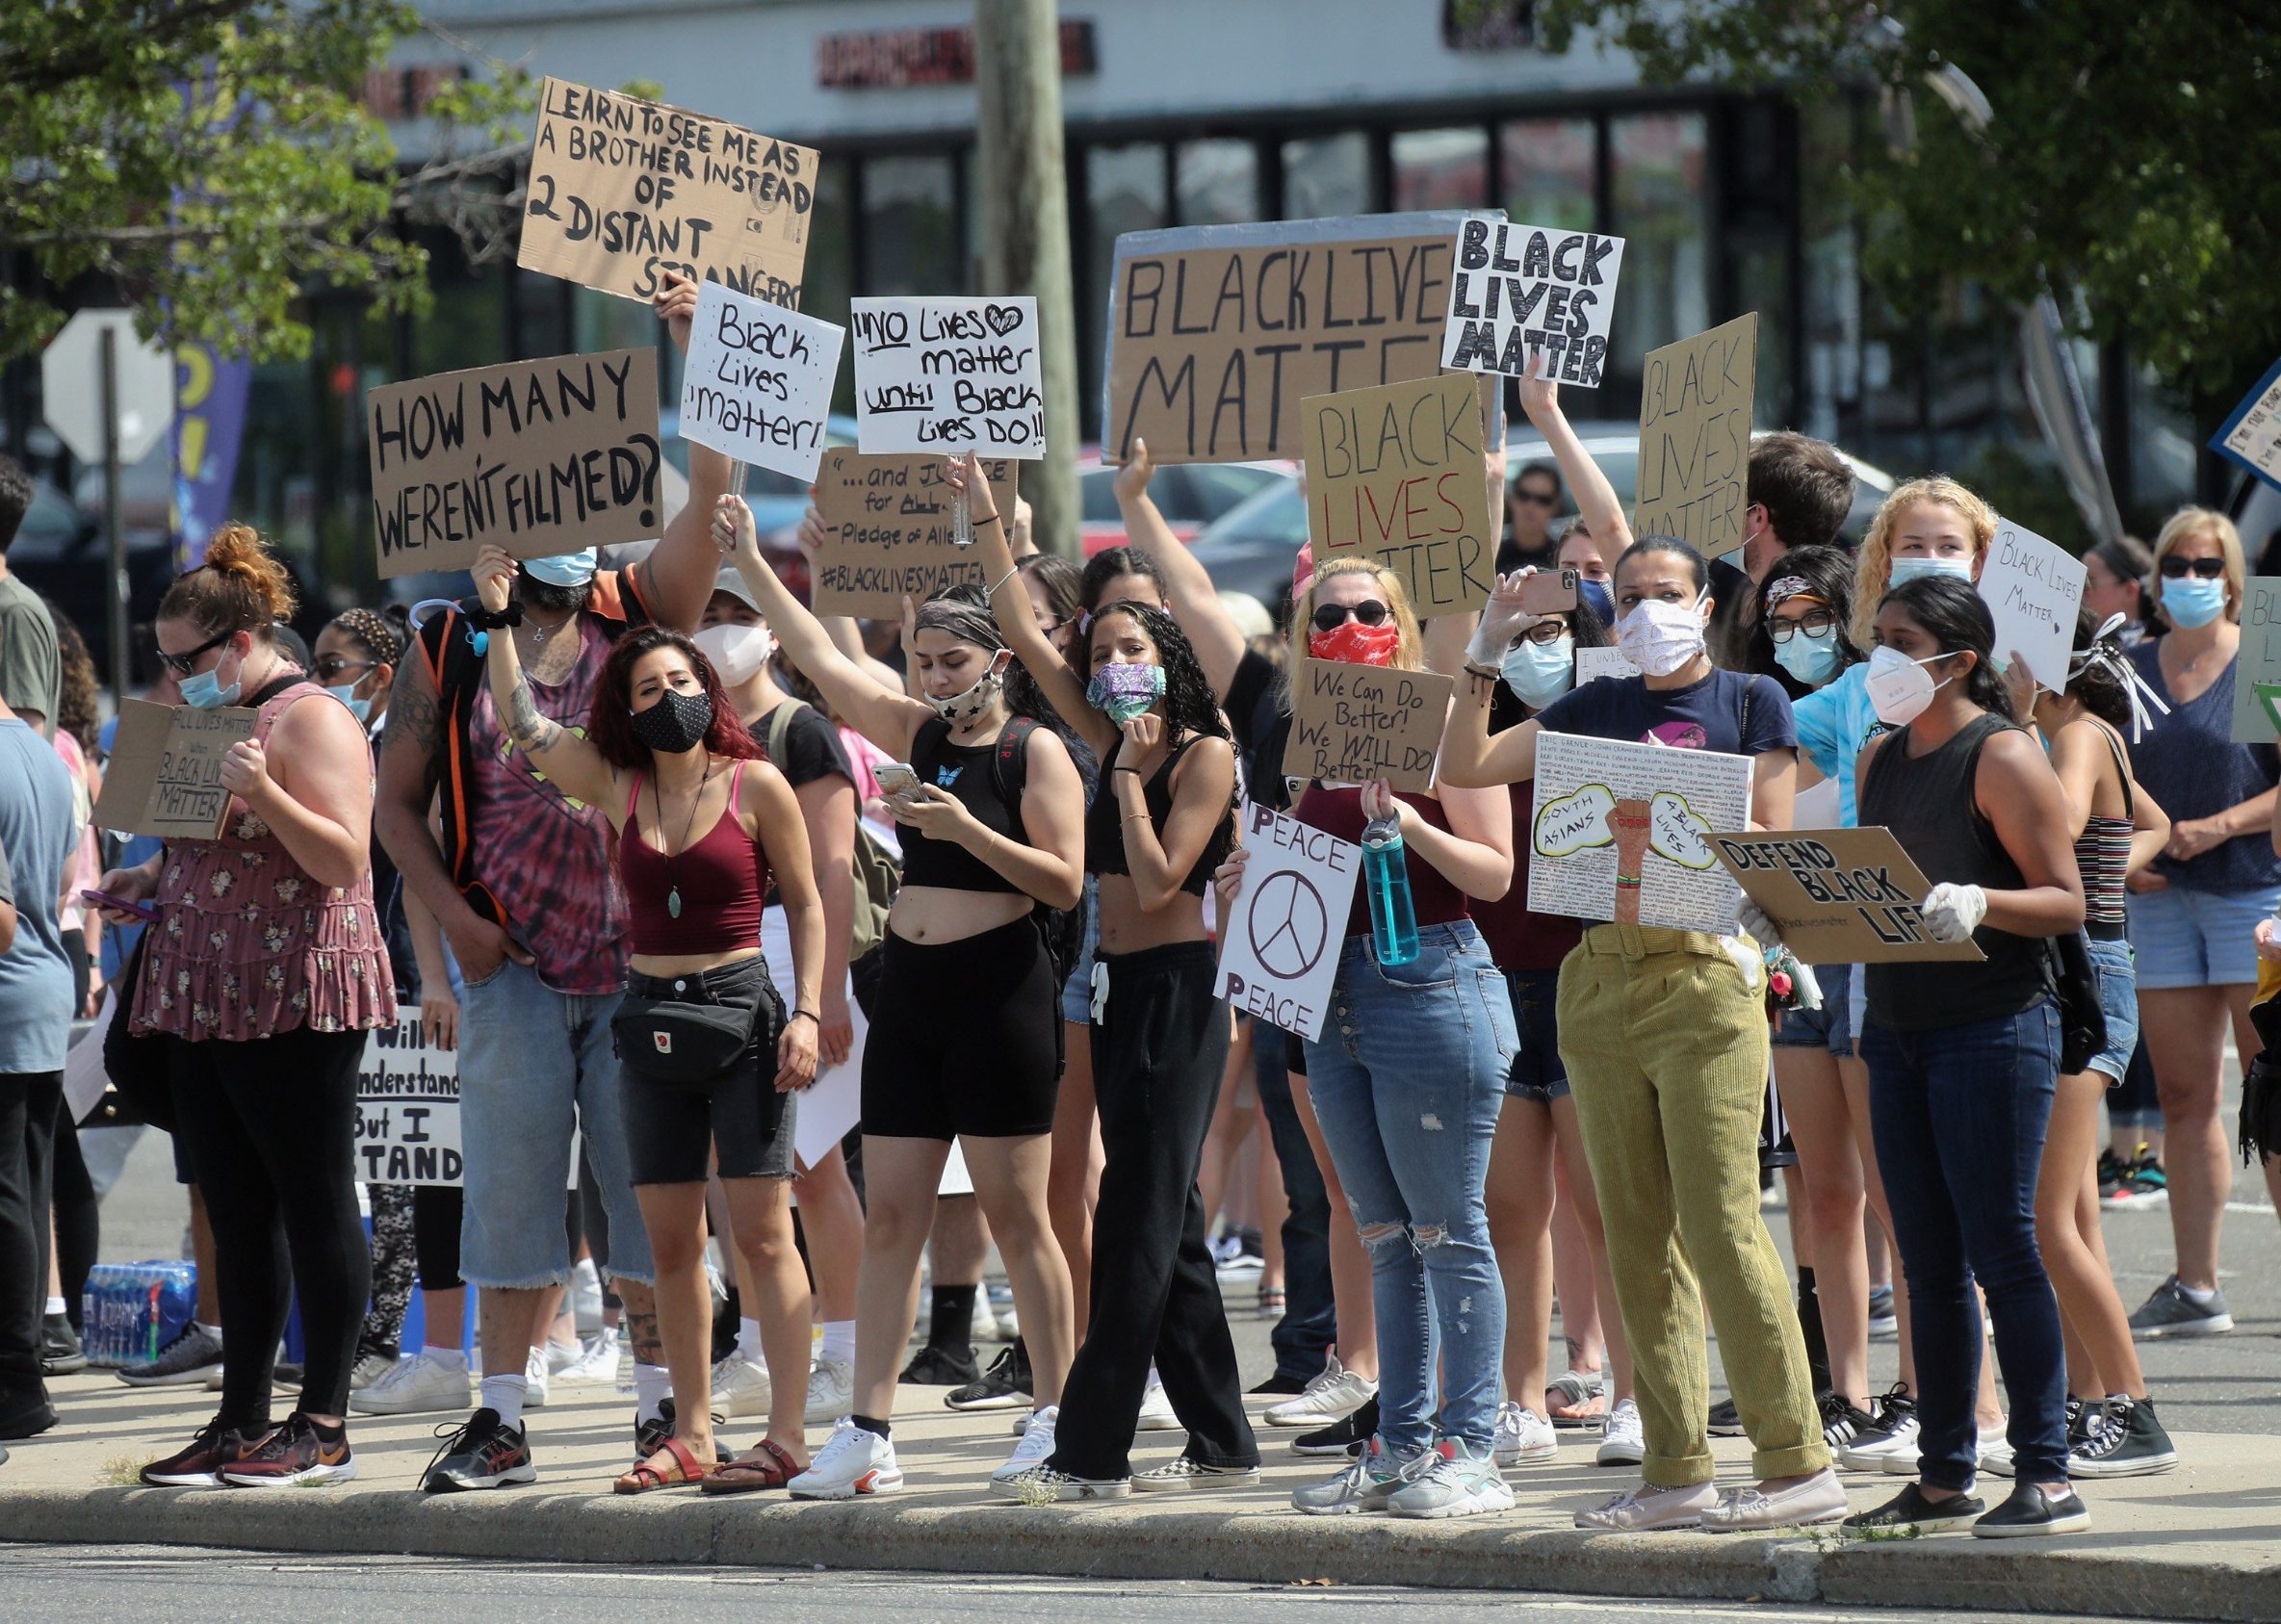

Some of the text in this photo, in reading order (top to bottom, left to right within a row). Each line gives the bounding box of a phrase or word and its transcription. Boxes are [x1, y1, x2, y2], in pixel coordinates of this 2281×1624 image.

[546, 81, 633, 133] LEARN
[667, 114, 713, 152] SEE
[723, 134, 758, 165] ME
[763, 146, 799, 175] AS
[539, 120, 811, 214] A BROTHER INSTEAD
[635, 174, 675, 211] OF
[528, 174, 713, 258] 2 DISTANT
[1461, 219, 1615, 287] BLACK
[1125, 244, 1448, 338] BLACK LIVE
[1453, 273, 1598, 339] LIVES
[718, 302, 809, 365] Black
[920, 306, 986, 342] Lives
[921, 345, 1033, 374] matter
[1451, 321, 1607, 386] MATTER
[717, 352, 789, 400] Lives
[954, 379, 1043, 414] Black
[1646, 335, 1740, 426] BLACK
[376, 354, 632, 473] HOW MANY
[1319, 391, 1476, 478] BLACK
[1642, 408, 1740, 503] LIVES
[505, 433, 661, 533] FILMED?
[865, 492, 893, 512] for
[1325, 473, 1464, 549] LIVES
[907, 530, 920, 544] of
[1319, 535, 1491, 606] TTER
[2000, 531, 2078, 602] BLACK LIVES
[2004, 584, 2053, 624] MATTER
[1314, 667, 1423, 709] We Can Do
[173, 710, 253, 734] ALL LIVES MATTER
[1335, 702, 1409, 734] Better!
[1300, 718, 1433, 772] We WILL DO
[158, 752, 199, 783] BLACK
[156, 785, 220, 818] MATTER
[1542, 796, 1594, 826] SOUTH
[1250, 805, 1349, 873] PEACE
[1543, 812, 1594, 850] ASIANS
[1656, 814, 1686, 854] LIVES
[1717, 838, 1838, 870] DEFEND
[1791, 866, 1912, 904] BLACK
[1856, 904, 1944, 944] LIF
[1222, 972, 1314, 1038] PEACE
[358, 1057, 460, 1096] nderstan
[354, 1106, 430, 1142] But I
[354, 1145, 463, 1181] TAND
